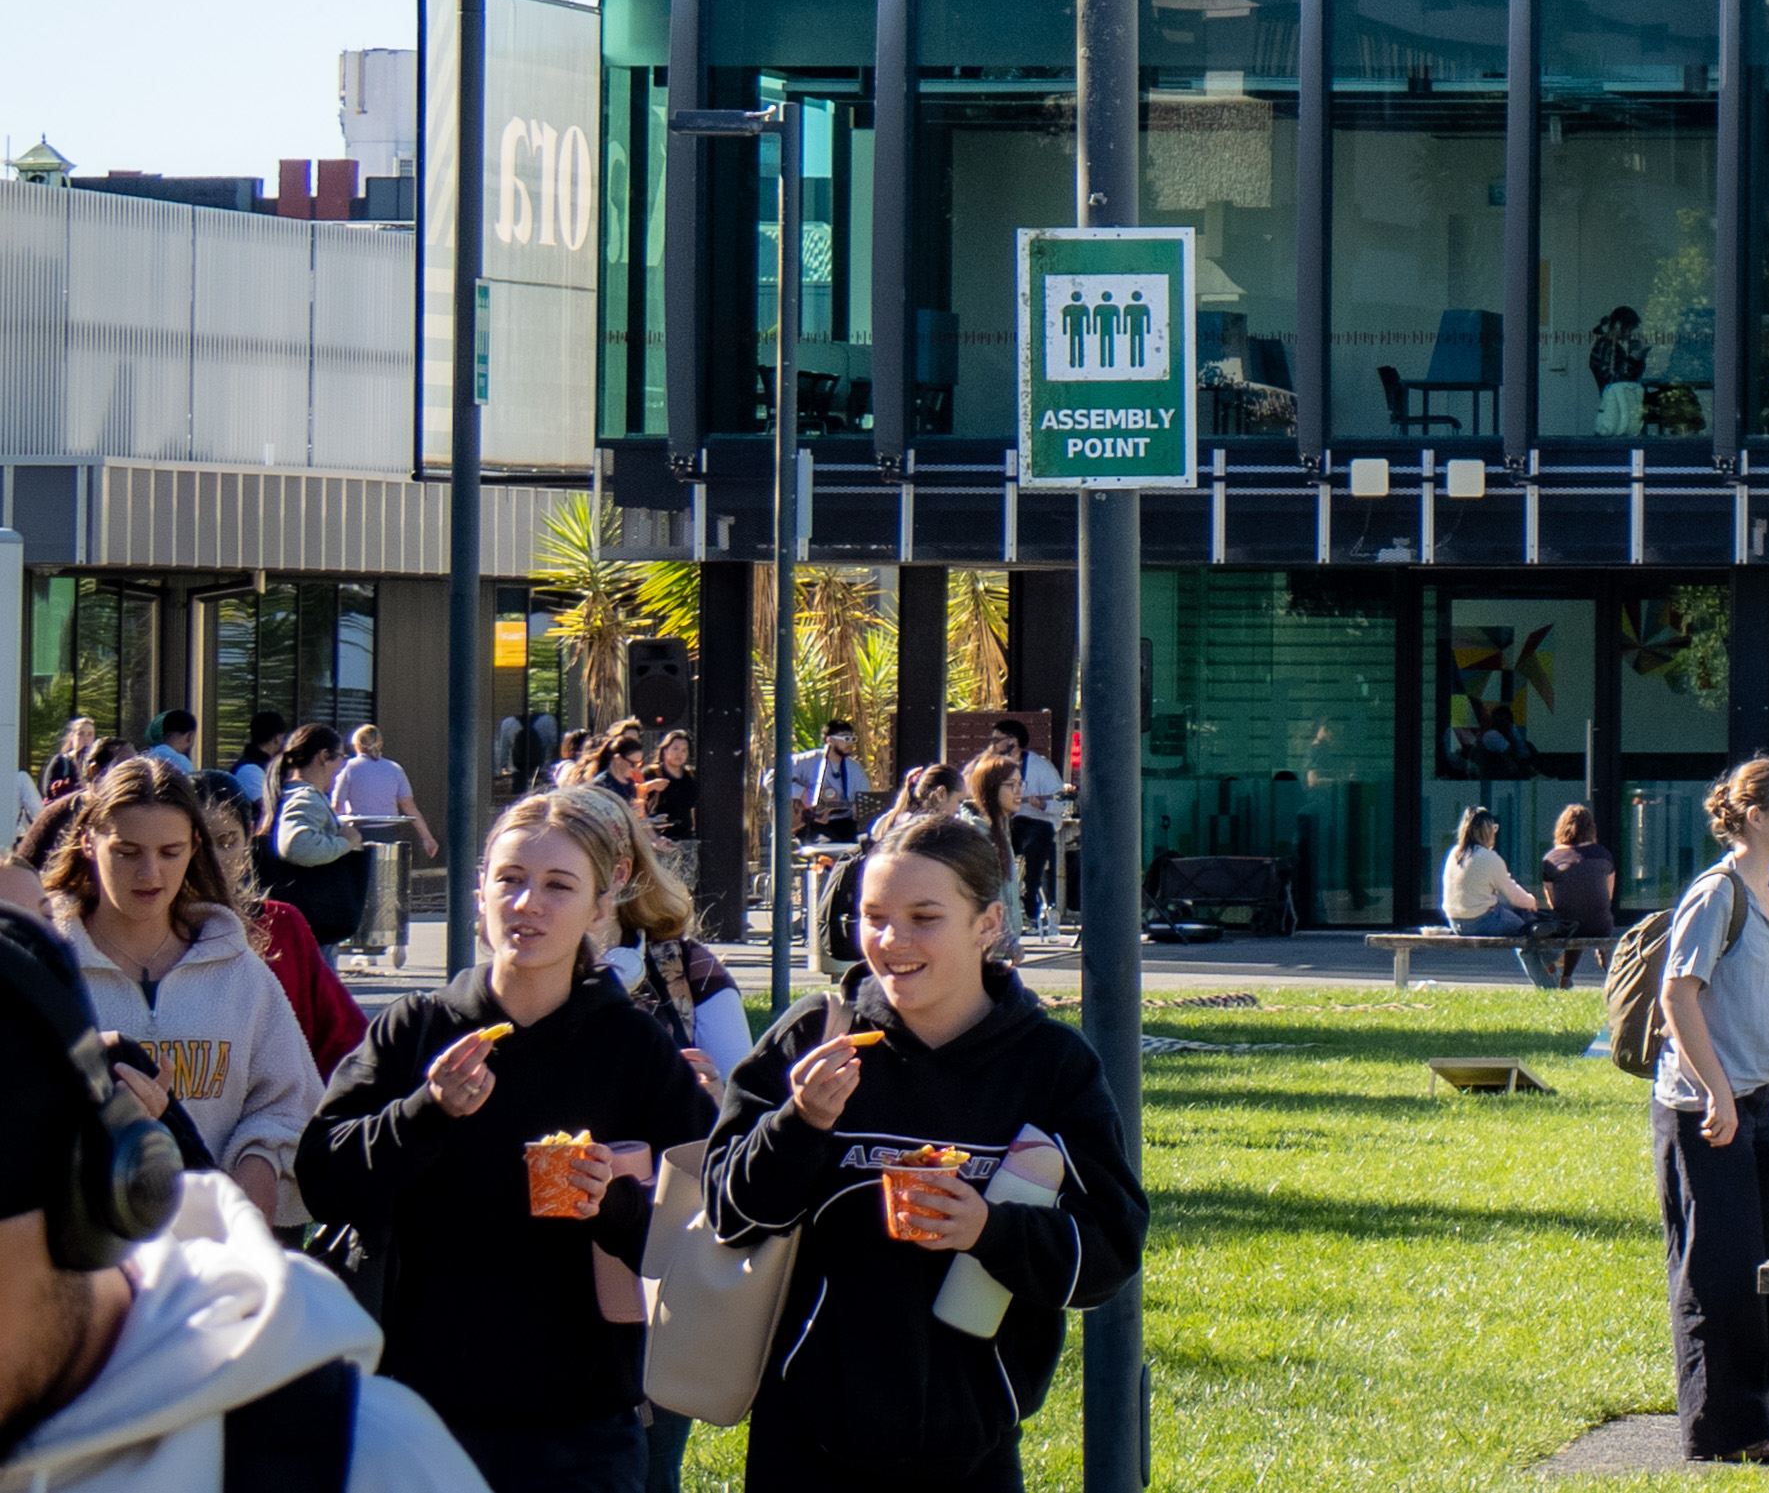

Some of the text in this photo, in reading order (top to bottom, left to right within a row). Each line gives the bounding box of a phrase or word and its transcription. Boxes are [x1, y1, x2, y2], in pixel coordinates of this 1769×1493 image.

[1041, 409, 1176, 430] ASSEMBLY
[1067, 437, 1151, 458] POINT
[840, 1145, 1001, 1180] ASND
